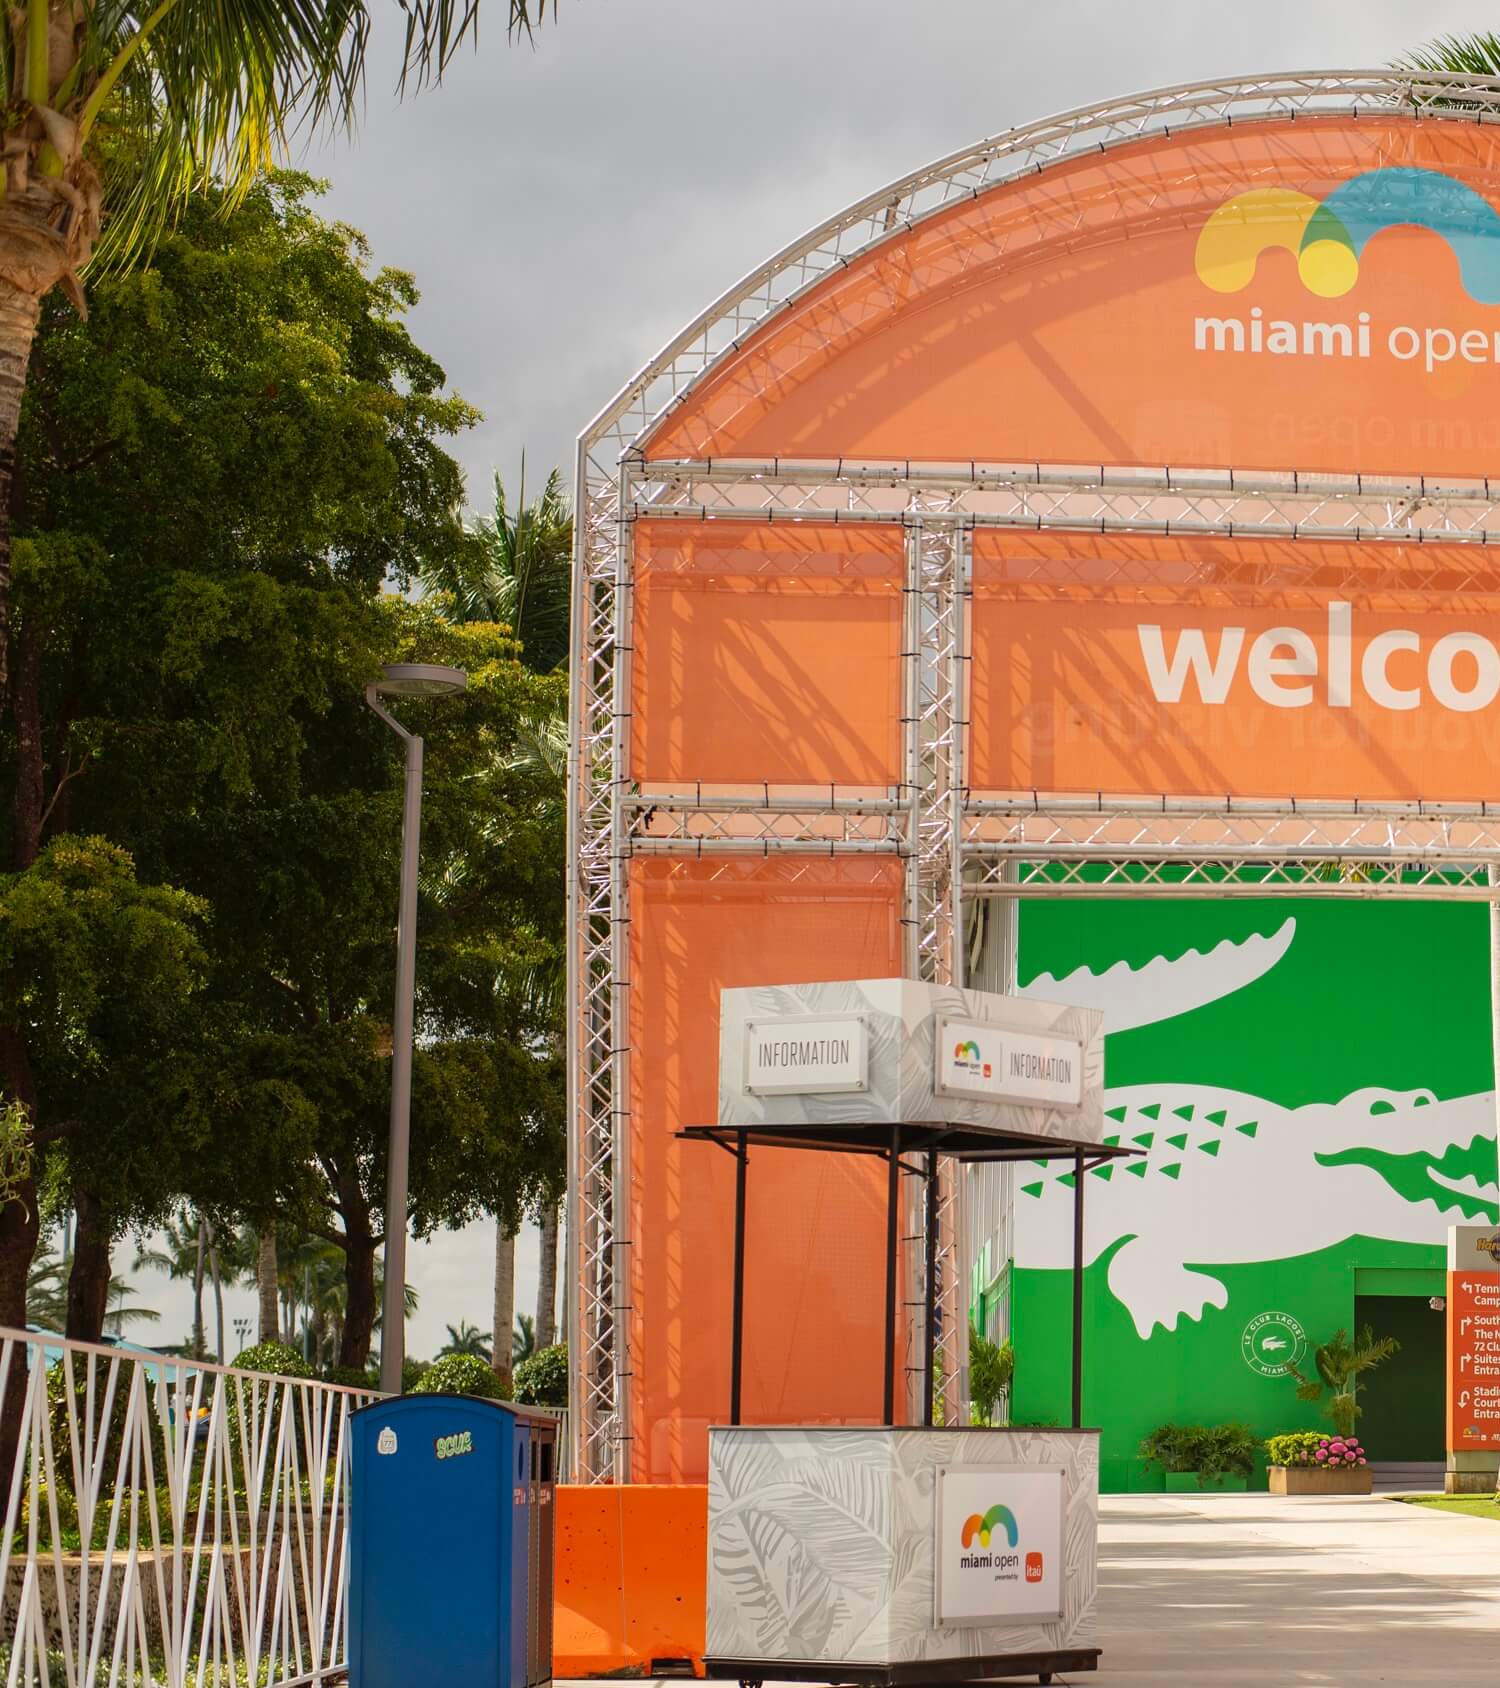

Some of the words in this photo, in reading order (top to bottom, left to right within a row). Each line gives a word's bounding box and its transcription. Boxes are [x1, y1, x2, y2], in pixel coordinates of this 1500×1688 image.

[1194, 308, 1371, 358] miami
[759, 1039, 850, 1068] INFORMATION
[1010, 1052, 1072, 1084] INFORMATION
[1474, 1283, 1500, 1294] Tenn
[1276, 1315, 1305, 1340] LACOST
[1474, 1329, 1494, 1339] The
[1474, 1342, 1486, 1352] 72
[960, 1552, 992, 1569] miami
[994, 1554, 1019, 1571] open
